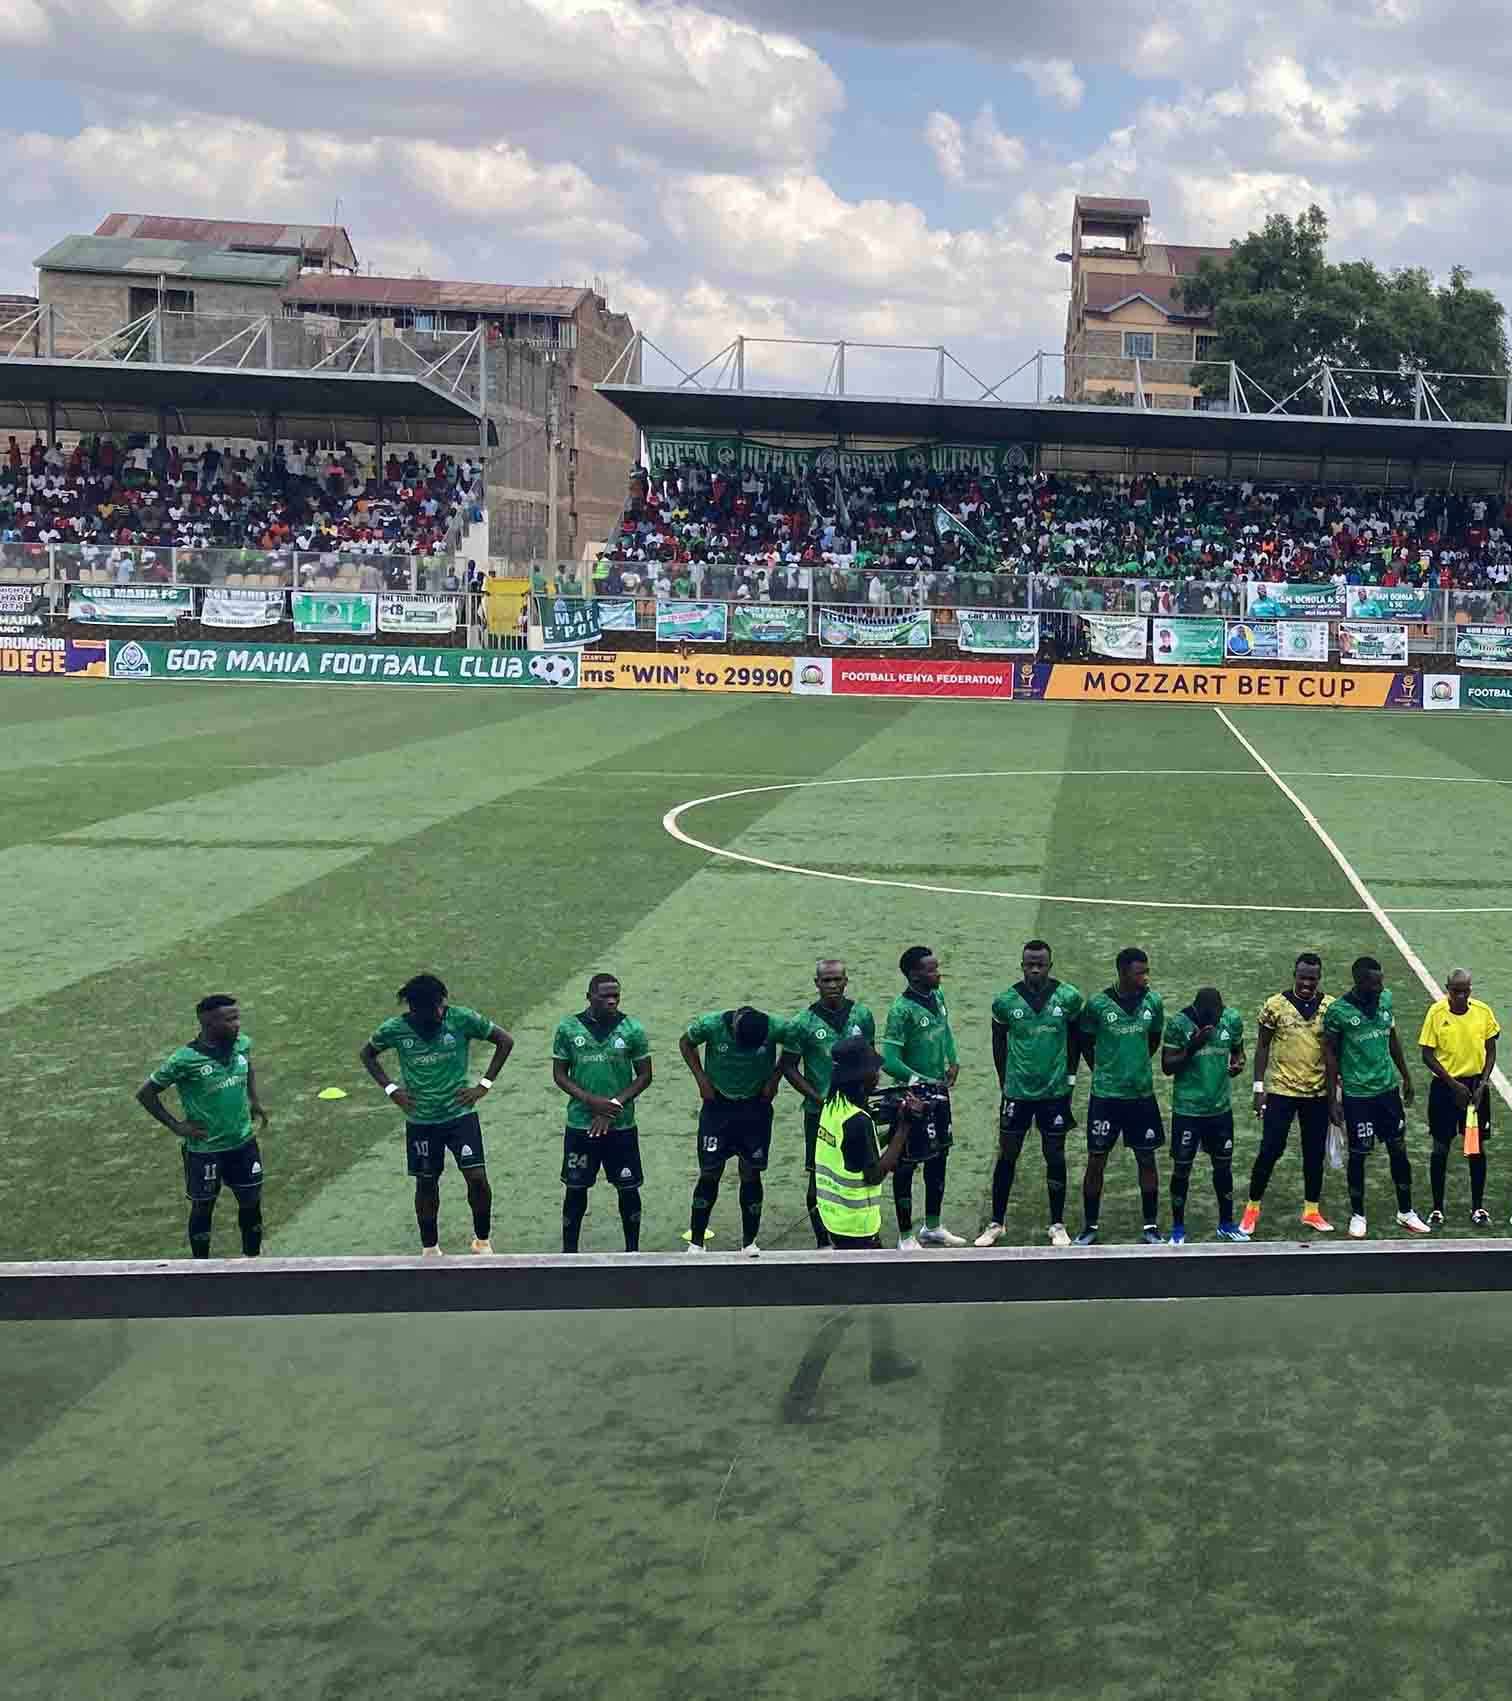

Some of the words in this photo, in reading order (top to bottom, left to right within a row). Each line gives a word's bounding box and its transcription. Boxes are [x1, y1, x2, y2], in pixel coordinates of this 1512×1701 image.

[161, 589, 178, 599] FC
[0, 650, 66, 673] DEGE
[166, 649, 218, 671] GOR
[226, 650, 311, 673] MAHIA
[319, 652, 450, 677] FOOTBALL
[459, 656, 523, 678] CLUB
[696, 669, 719, 685] to
[723, 668, 793, 687] 29990
[841, 670, 897, 682] FOOTBALL
[898, 672, 933, 683] KENYA
[936, 672, 1004, 685] FEDERATION
[1083, 671, 1227, 695] MOZZART
[1238, 676, 1290, 696] BET
[1299, 677, 1355, 698] CUP
[1091, 1119, 1110, 1136] 30
[1357, 1121, 1374, 1138] 26
[1182, 1130, 1192, 1145] 2
[567, 1152, 588, 1169] 24
[203, 1163, 217, 1181] 11
